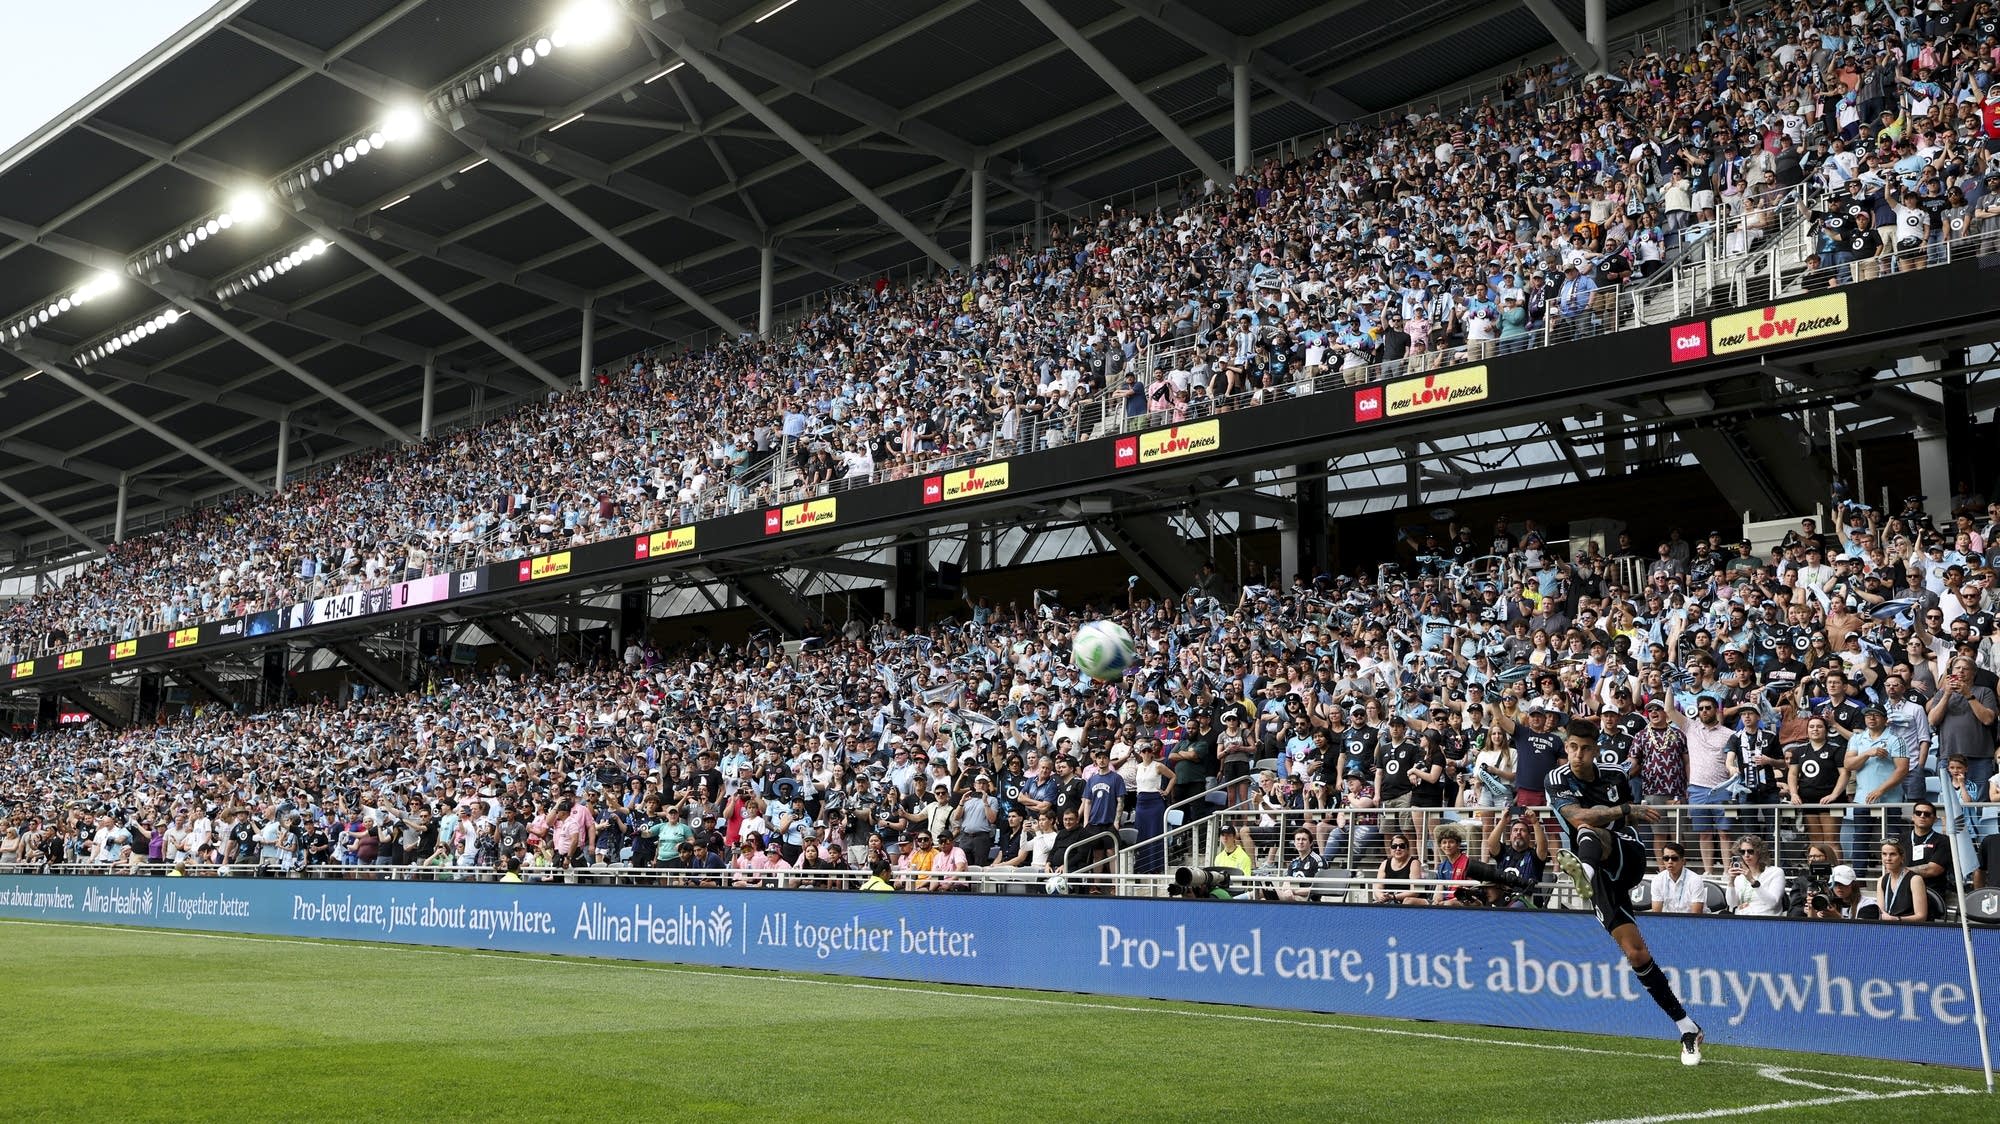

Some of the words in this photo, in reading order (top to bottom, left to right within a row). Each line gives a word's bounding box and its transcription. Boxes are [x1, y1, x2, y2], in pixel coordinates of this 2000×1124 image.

[1718, 333, 1745, 347] new
[1747, 318, 1797, 342] LOW
[1796, 314, 1842, 336] prices
[1676, 335, 1700, 349] Cub
[1360, 398, 1378, 411] Cub
[1391, 399, 1411, 410] new
[1412, 386, 1450, 406] LOW
[1448, 384, 1483, 402] prices
[1160, 437, 1190, 454] LOW
[1188, 435, 1216, 452] prices
[961, 479, 984, 491] LOW
[796, 511, 816, 524] LOW
[662, 539, 678, 550] LOW
[542, 563, 556, 573] LOW
[401, 584, 408, 605] 0
[324, 596, 354, 619] 41:40
[11, 885, 33, 907] about
[34, 886, 75, 914] anywhere.
[162, 892, 175, 913] All
[177, 893, 219, 920] together
[219, 894, 250, 917] better.
[292, 894, 351, 923] Pro-level
[353, 904, 386, 930] care,
[388, 897, 418, 933] just
[420, 897, 466, 929] about
[469, 900, 556, 939] anywhere.
[757, 912, 787, 946] All
[794, 915, 893, 959] together
[900, 917, 977, 957] better.
[1098, 924, 1265, 976] Pro-level
[1275, 945, 1375, 994] care,
[1385, 936, 1474, 1000] just
[1486, 939, 1640, 1001] about
